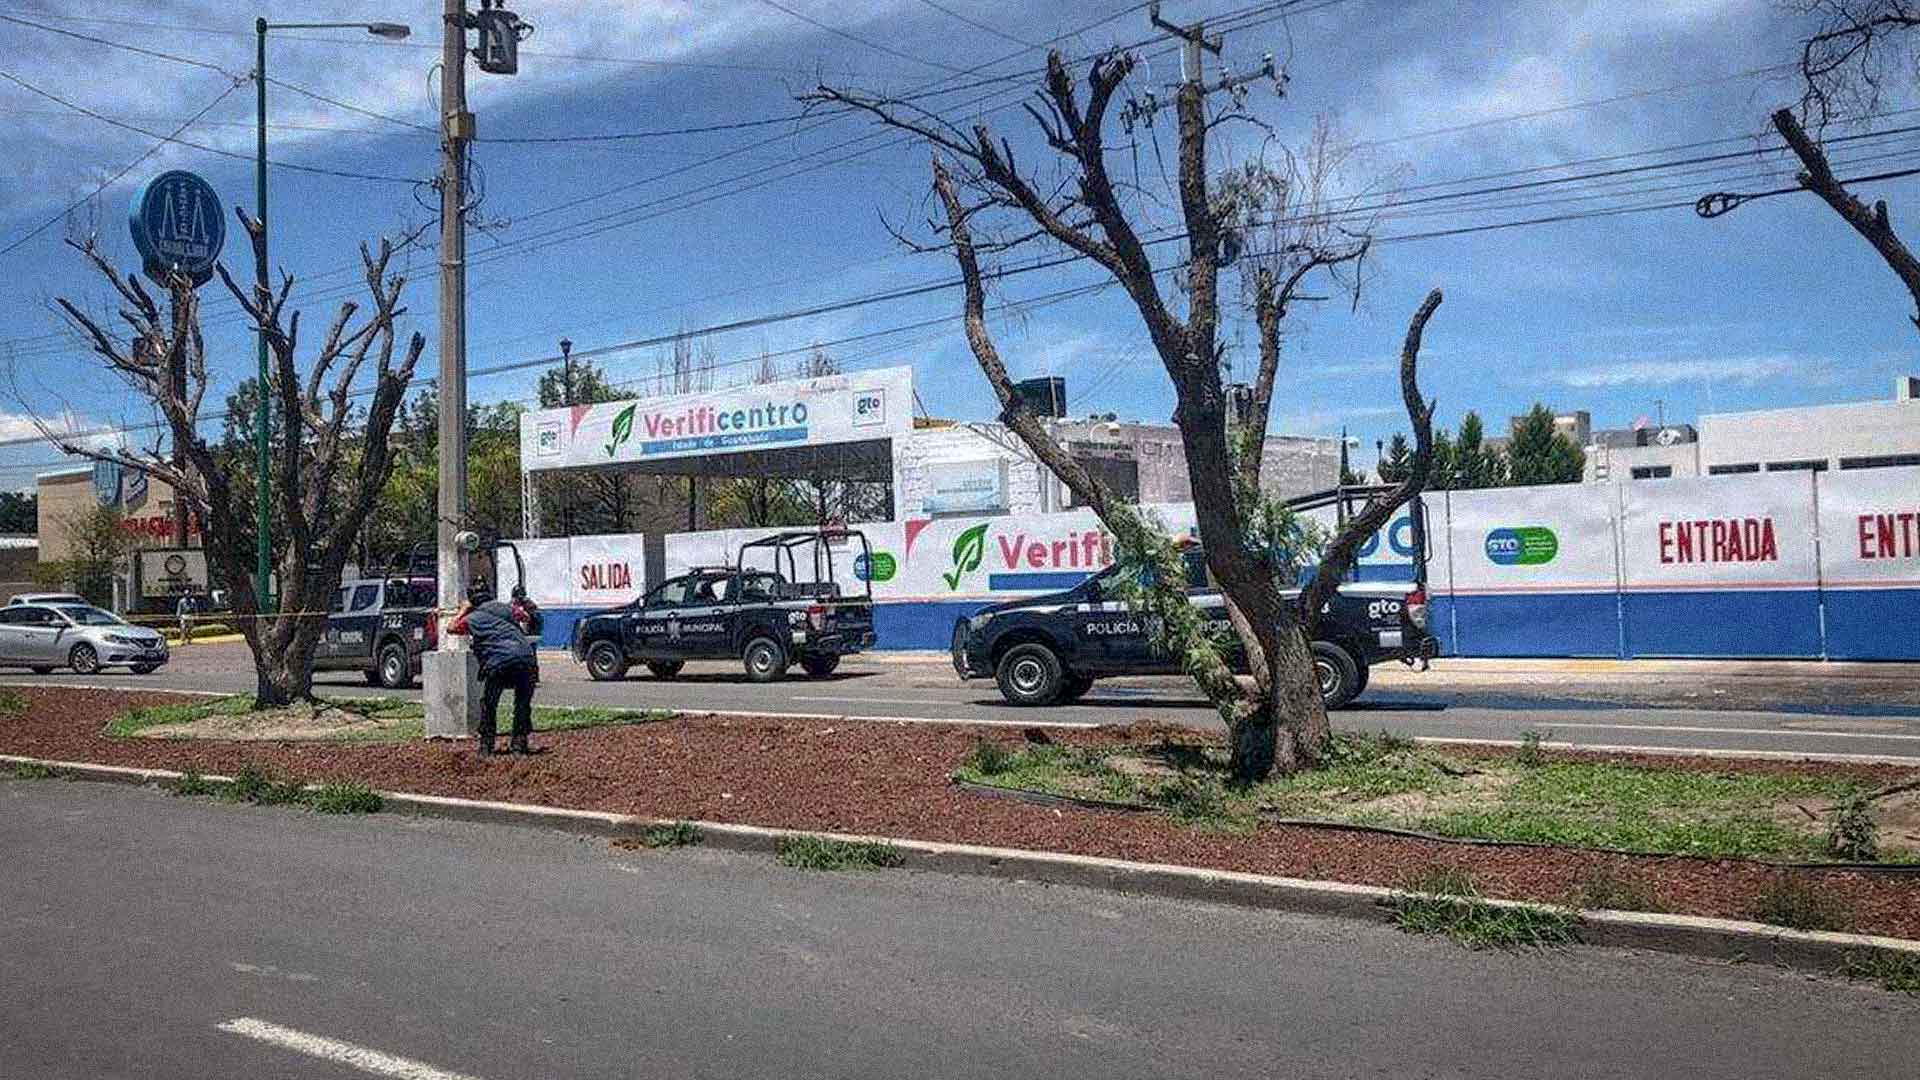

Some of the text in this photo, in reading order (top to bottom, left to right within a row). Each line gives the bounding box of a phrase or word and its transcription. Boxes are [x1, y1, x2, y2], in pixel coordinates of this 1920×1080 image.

[644, 402, 808, 438] Verificentro
[1658, 517, 1779, 564] ENTRADA
[1857, 512, 1920, 560] ENT
[581, 562, 632, 590] SALIDA
[1368, 598, 1401, 619] gto
[1086, 618, 1140, 635] POLICÍA
